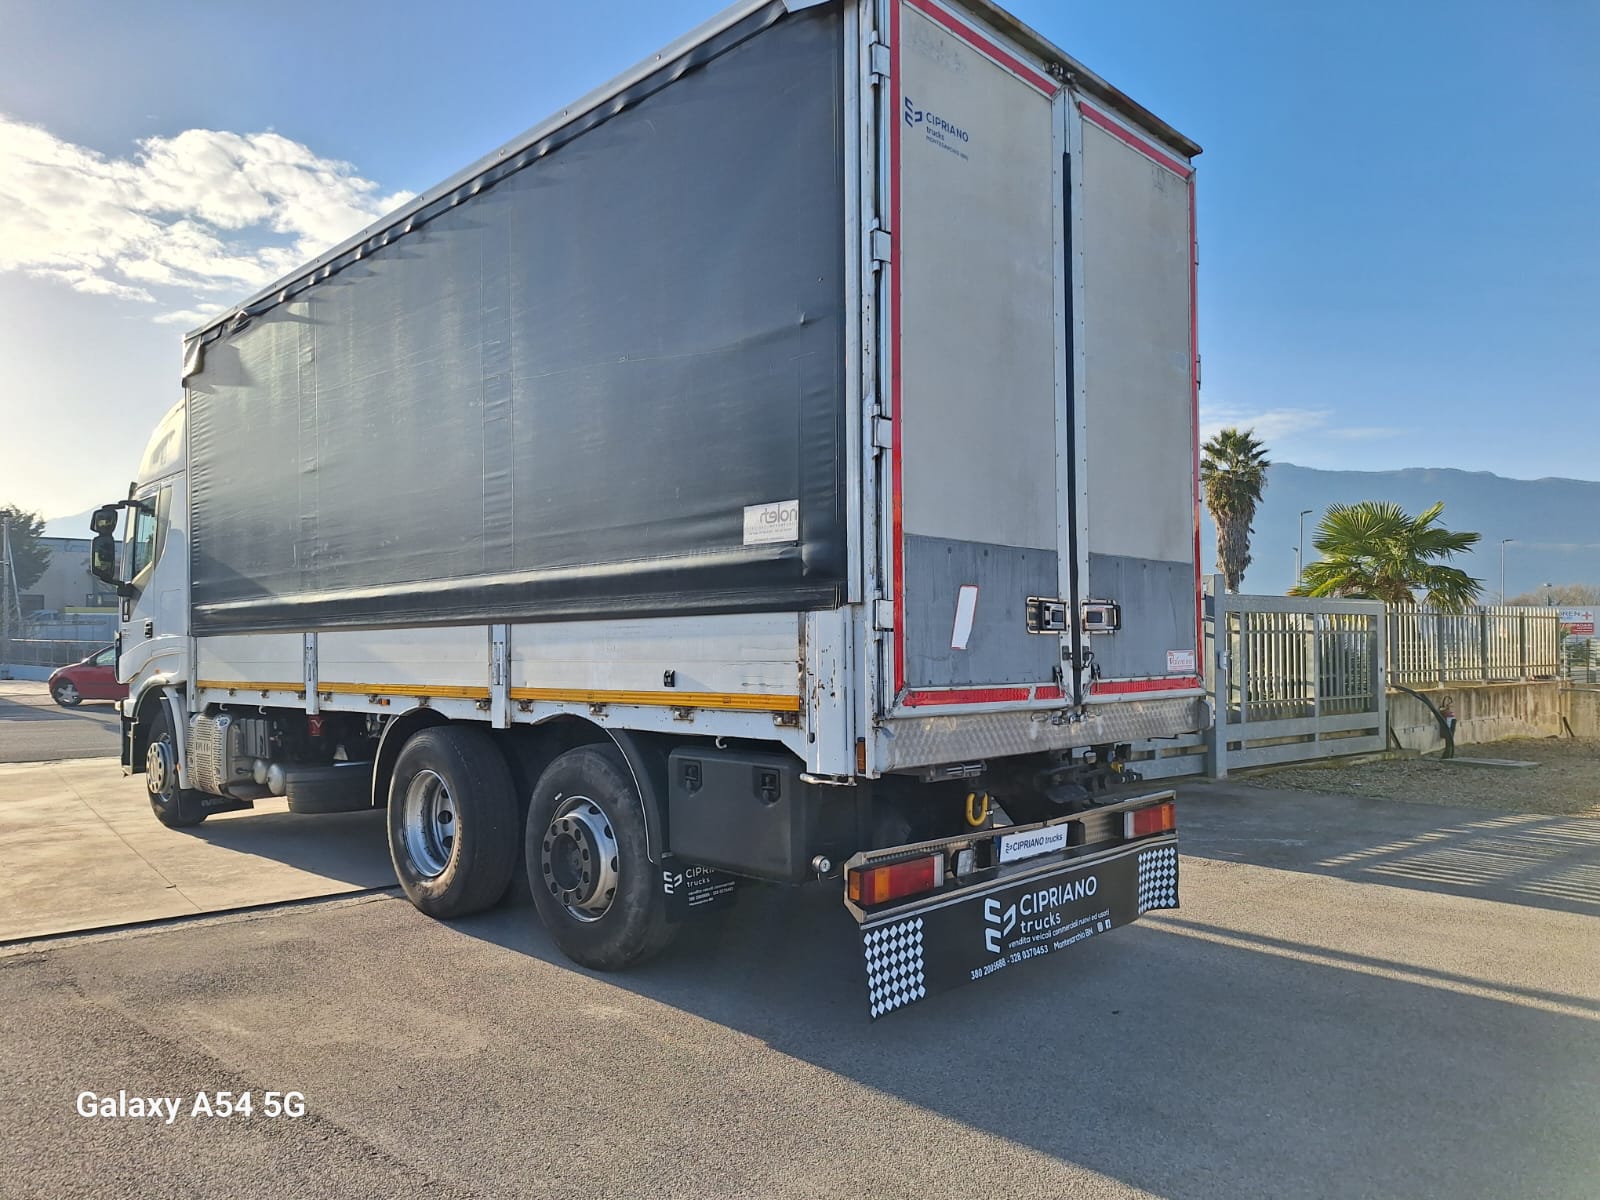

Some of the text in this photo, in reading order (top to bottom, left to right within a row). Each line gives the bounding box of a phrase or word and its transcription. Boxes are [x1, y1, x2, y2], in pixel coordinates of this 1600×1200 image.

[926, 112, 969, 143] CIPRIANO
[926, 126, 945, 141] trucks
[1012, 833, 1063, 851] CIPRIANO trucks
[686, 877, 710, 888] trucks
[1019, 875, 1098, 916] CIPRIANO
[1020, 911, 1062, 934] trucks
[1008, 935, 1031, 949] vendita
[1032, 930, 1052, 941] veicoli
[970, 968, 983, 981] 380
[1009, 952, 1021, 964] 328
[1021, 944, 1049, 960] 0370453
